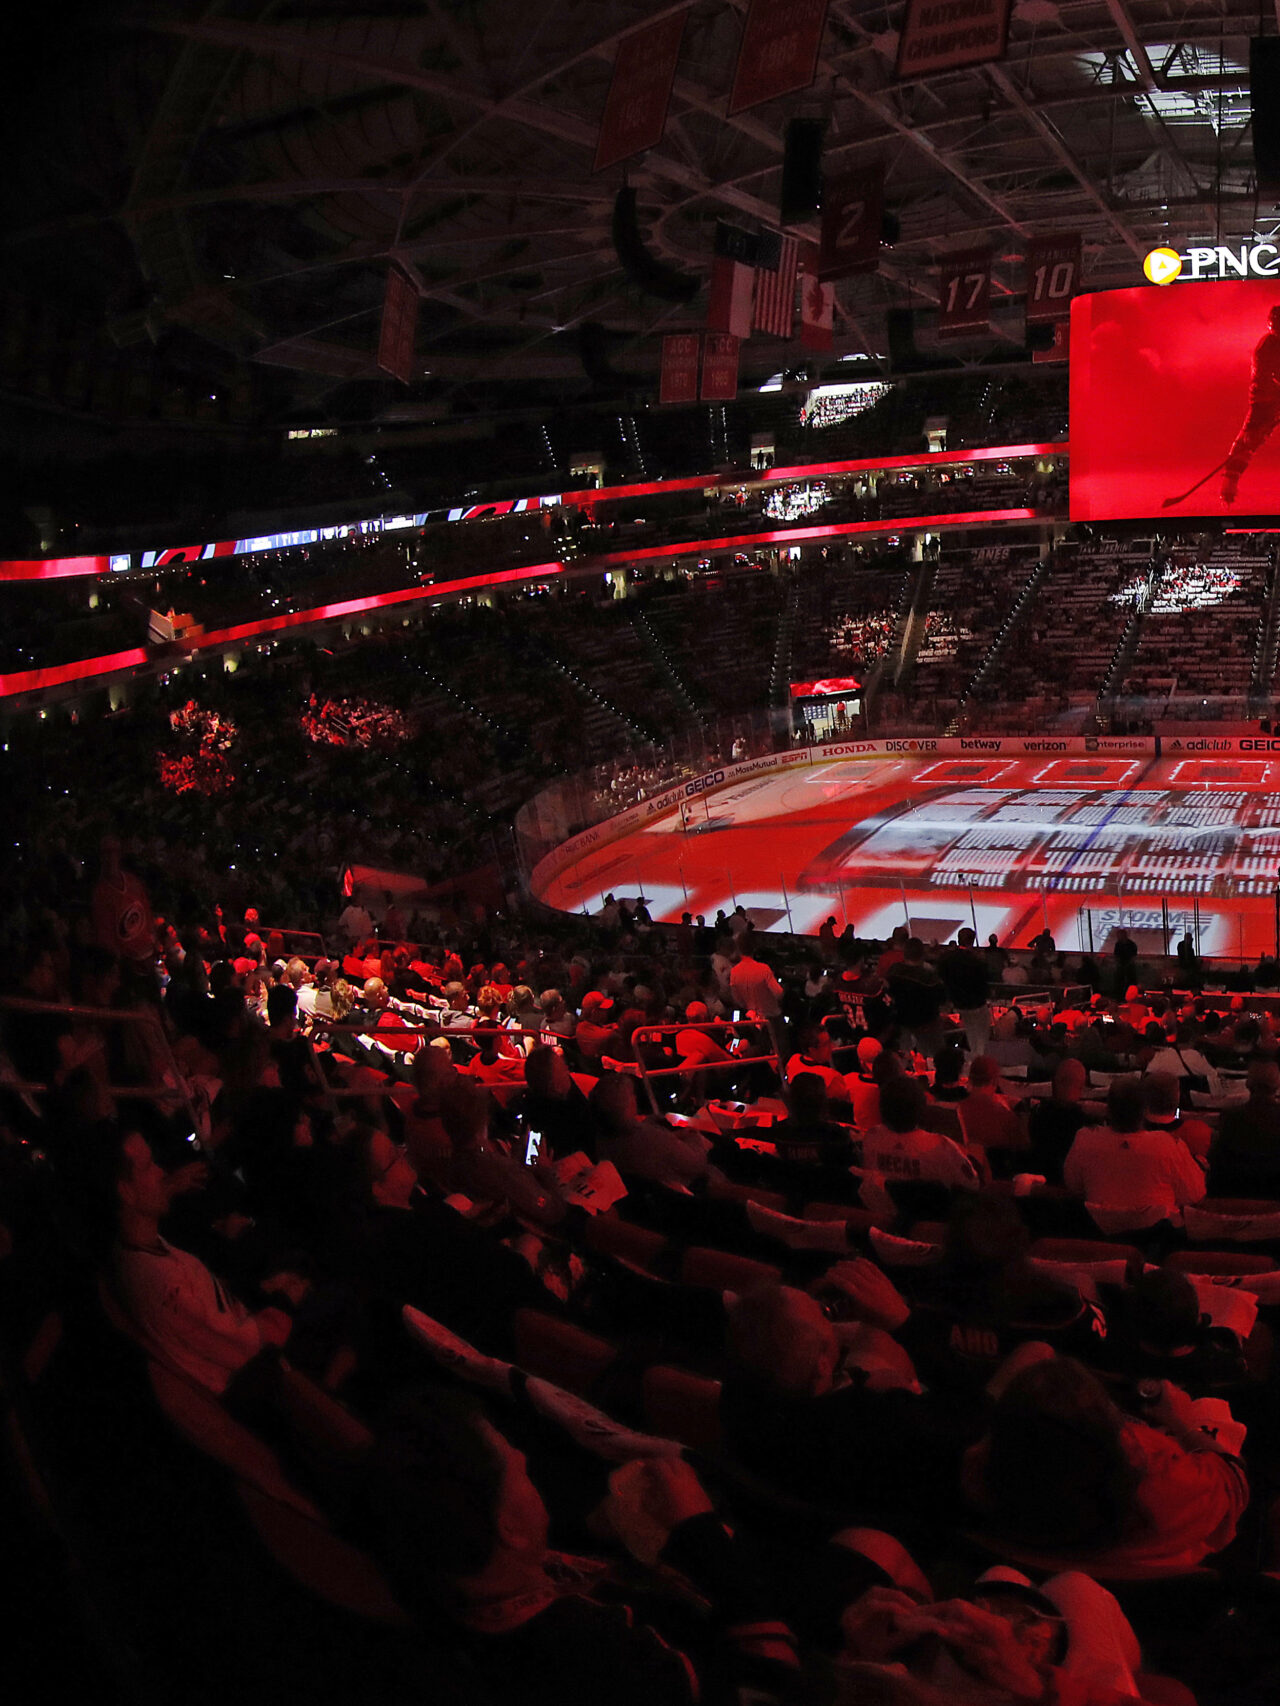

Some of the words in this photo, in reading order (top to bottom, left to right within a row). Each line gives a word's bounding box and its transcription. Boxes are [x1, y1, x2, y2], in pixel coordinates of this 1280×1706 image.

[836, 201, 865, 248] 2
[1189, 245, 1278, 277] PNC
[1033, 262, 1074, 301] 10
[946, 273, 986, 313] 17
[823, 743, 877, 757] HONDA
[886, 740, 937, 751] DISCOVER
[960, 739, 1002, 751] betway
[1024, 740, 1067, 751] verizon
[1187, 738, 1232, 750] adiclub
[781, 752, 808, 764] ESPN
[735, 757, 778, 776] MassMutual
[685, 770, 725, 797] GEICO
[656, 788, 685, 810] adiclub
[1101, 910, 1184, 923] STORM
